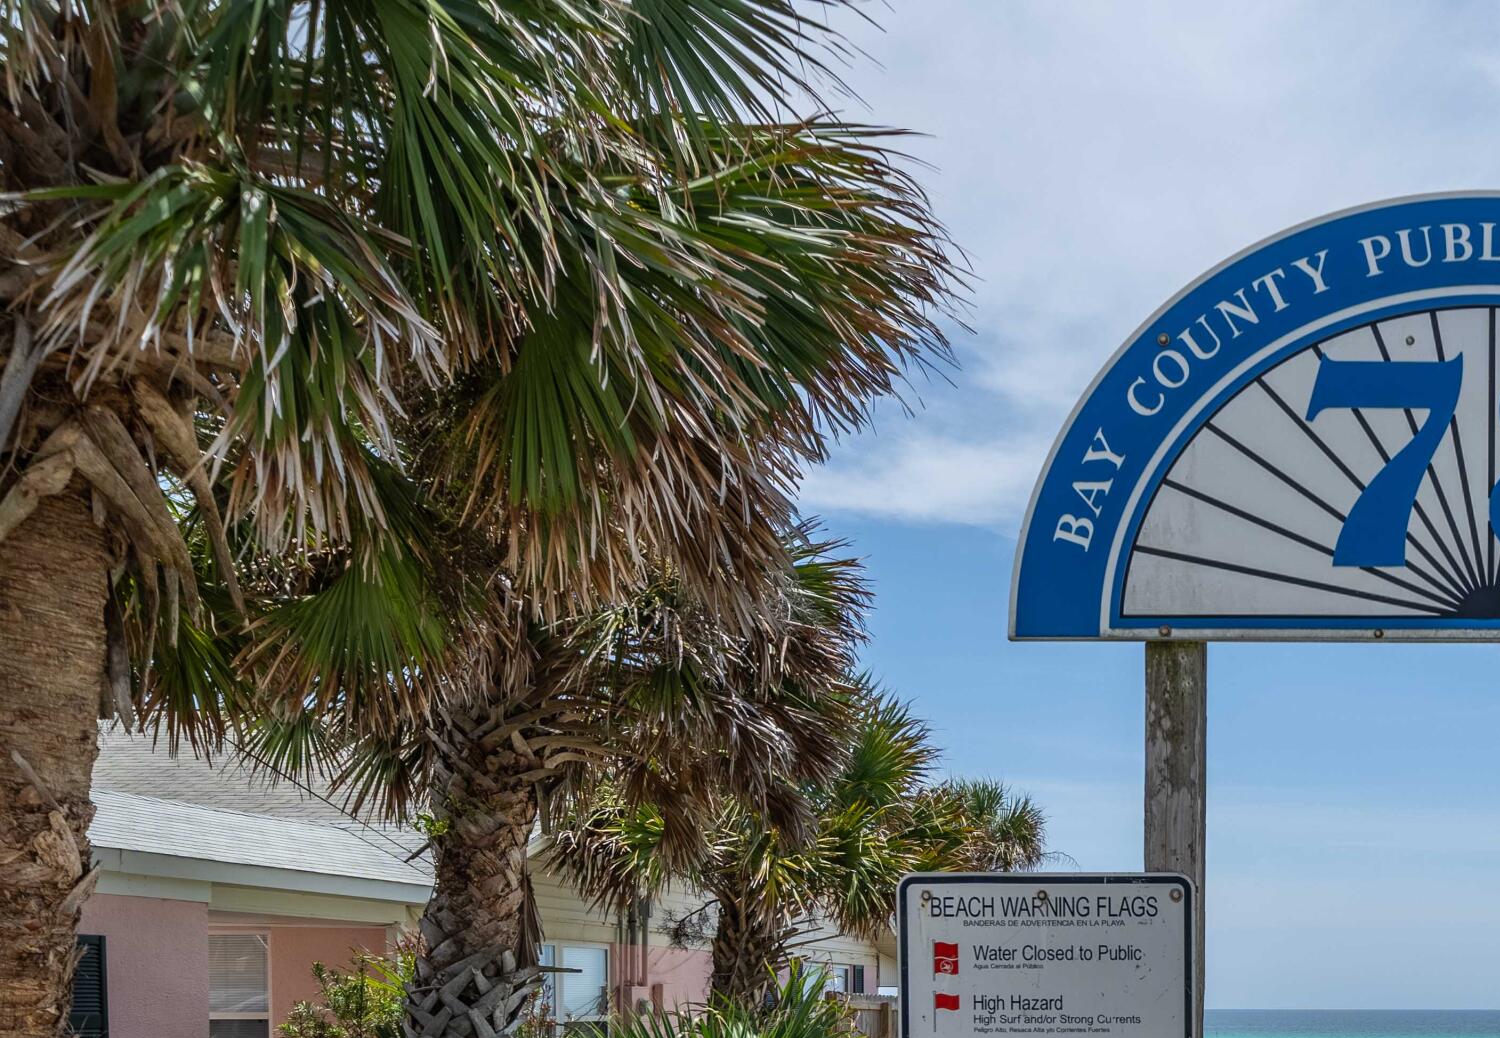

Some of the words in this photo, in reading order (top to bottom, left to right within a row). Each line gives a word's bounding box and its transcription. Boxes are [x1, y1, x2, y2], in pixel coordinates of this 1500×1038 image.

[1053, 428, 1125, 553] BAY
[1126, 249, 1331, 418] COUNTY
[930, 896, 995, 917] BEACH
[1000, 896, 1090, 918] WARNING
[1097, 896, 1158, 917] FLAGS
[963, 919, 1006, 927] BANDERAS
[1008, 919, 1019, 927] DE
[1020, 919, 1075, 927] ADVERTENCIA
[1077, 919, 1088, 927] EN
[1089, 919, 1099, 927] LA
[1101, 919, 1125, 927] PLAYA
[973, 945, 1017, 961] Water
[1022, 945, 1074, 961] Closed
[1080, 946, 1092, 961] to
[1098, 945, 1142, 961] Public
[973, 994, 1005, 1014] High
[1010, 994, 1063, 1011] Hazard
[973, 1014, 996, 1026] High
[1000, 1014, 1022, 1024] Surf
[1024, 1014, 1056, 1024] and/or
[1059, 1015, 1094, 1026] Strong
